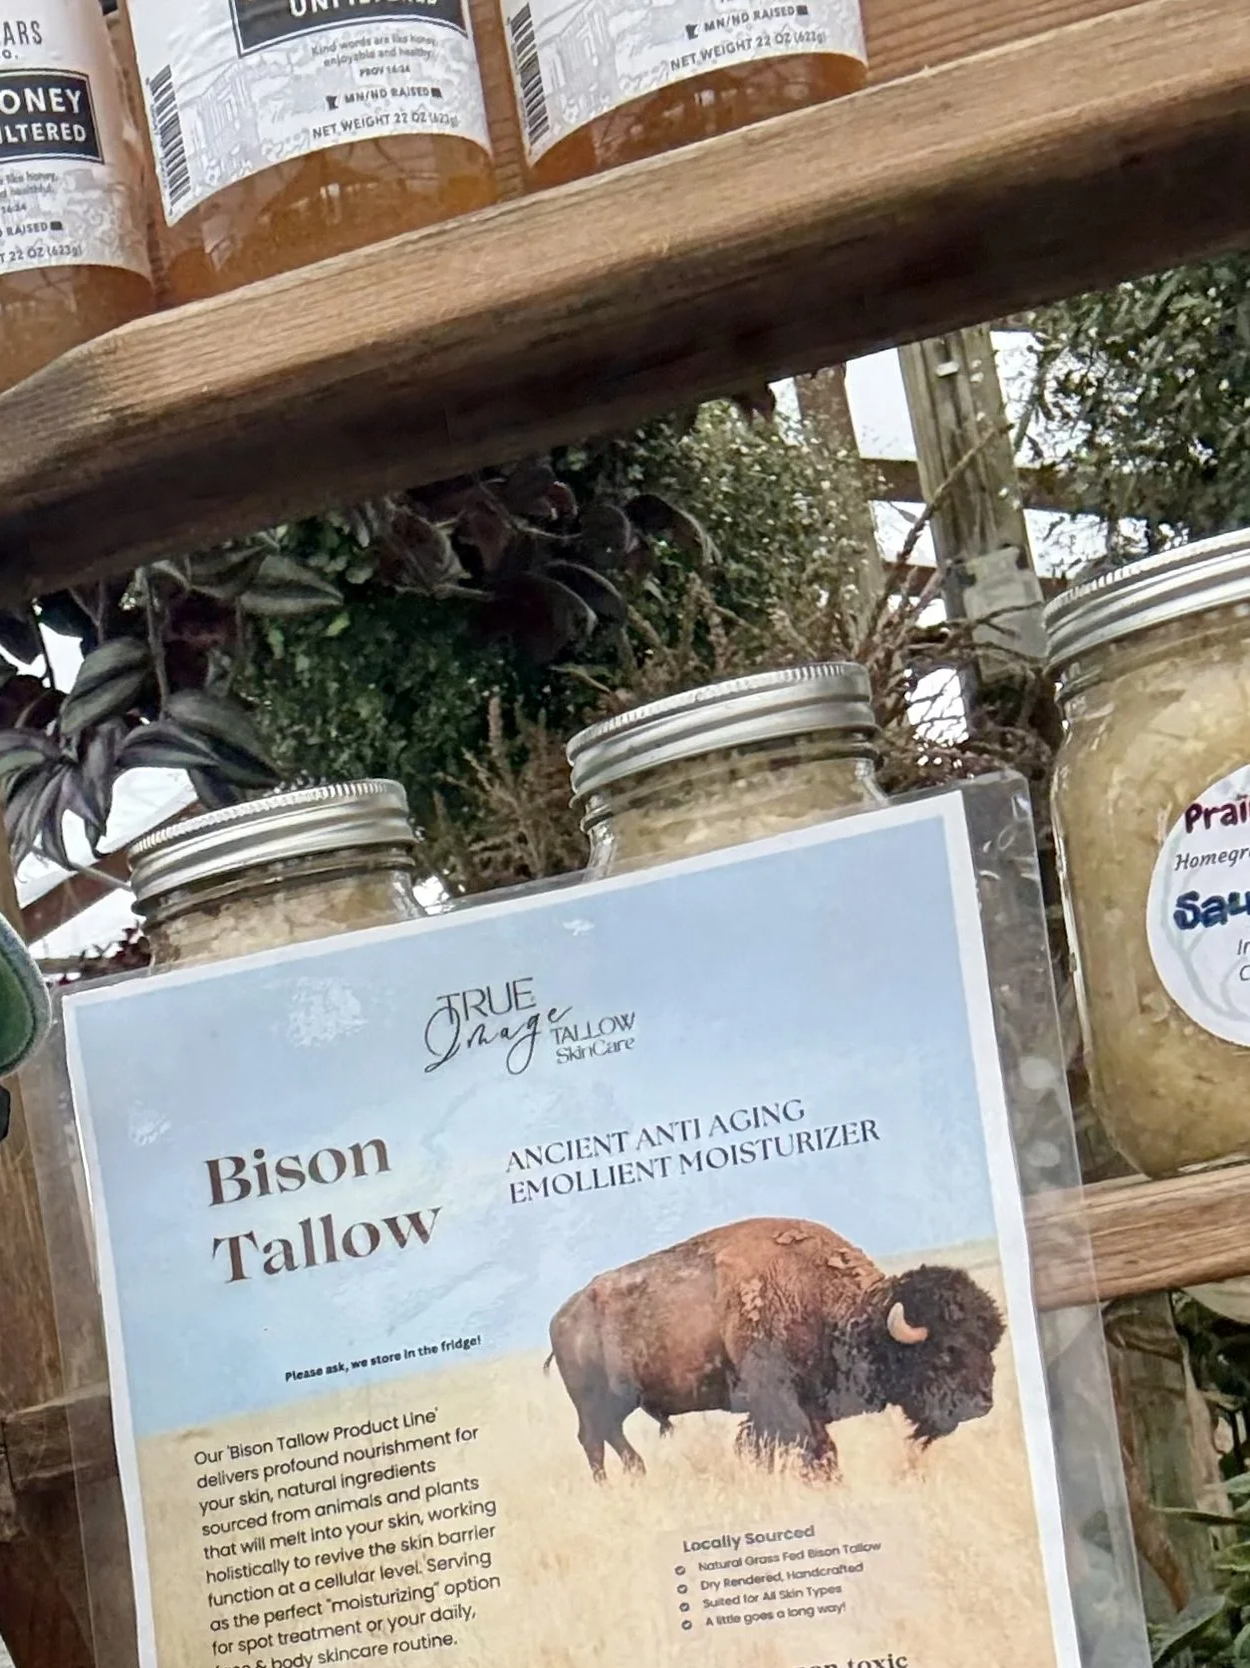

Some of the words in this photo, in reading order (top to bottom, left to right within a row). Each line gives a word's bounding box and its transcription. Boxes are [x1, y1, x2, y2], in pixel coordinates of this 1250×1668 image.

[312, 124, 338, 140] NET
[340, 114, 390, 132] WEIGHT
[394, 112, 408, 124] 22
[411, 112, 427, 123] OZ
[6, 222, 48, 236] RAISED
[9, 250, 24, 262] 22
[27, 246, 45, 258] OZ
[1185, 795, 1250, 834] Prai
[1174, 846, 1250, 871] Homegr
[437, 977, 536, 1024] TRUE
[425, 1006, 573, 1075] Image
[551, 1012, 635, 1045] TALLOW
[556, 1036, 635, 1065] SkinCare
[505, 1130, 628, 1173] ANCIENT
[635, 1118, 702, 1152] ANTI
[708, 1099, 806, 1137] AGING
[204, 1137, 391, 1208] Bison
[509, 1157, 670, 1204] EMOLLIENT
[678, 1119, 881, 1177] MOISTURIZER
[212, 1206, 443, 1285] Tallow
[285, 1367, 323, 1382] Please
[325, 1361, 349, 1374] ask,
[350, 1359, 367, 1369] we
[370, 1353, 401, 1366] store
[403, 1349, 415, 1359] in
[417, 1345, 438, 1356] the
[440, 1335, 481, 1351] fridge!
[683, 1534, 741, 1553] Locally
[744, 1524, 815, 1544] Sourced
